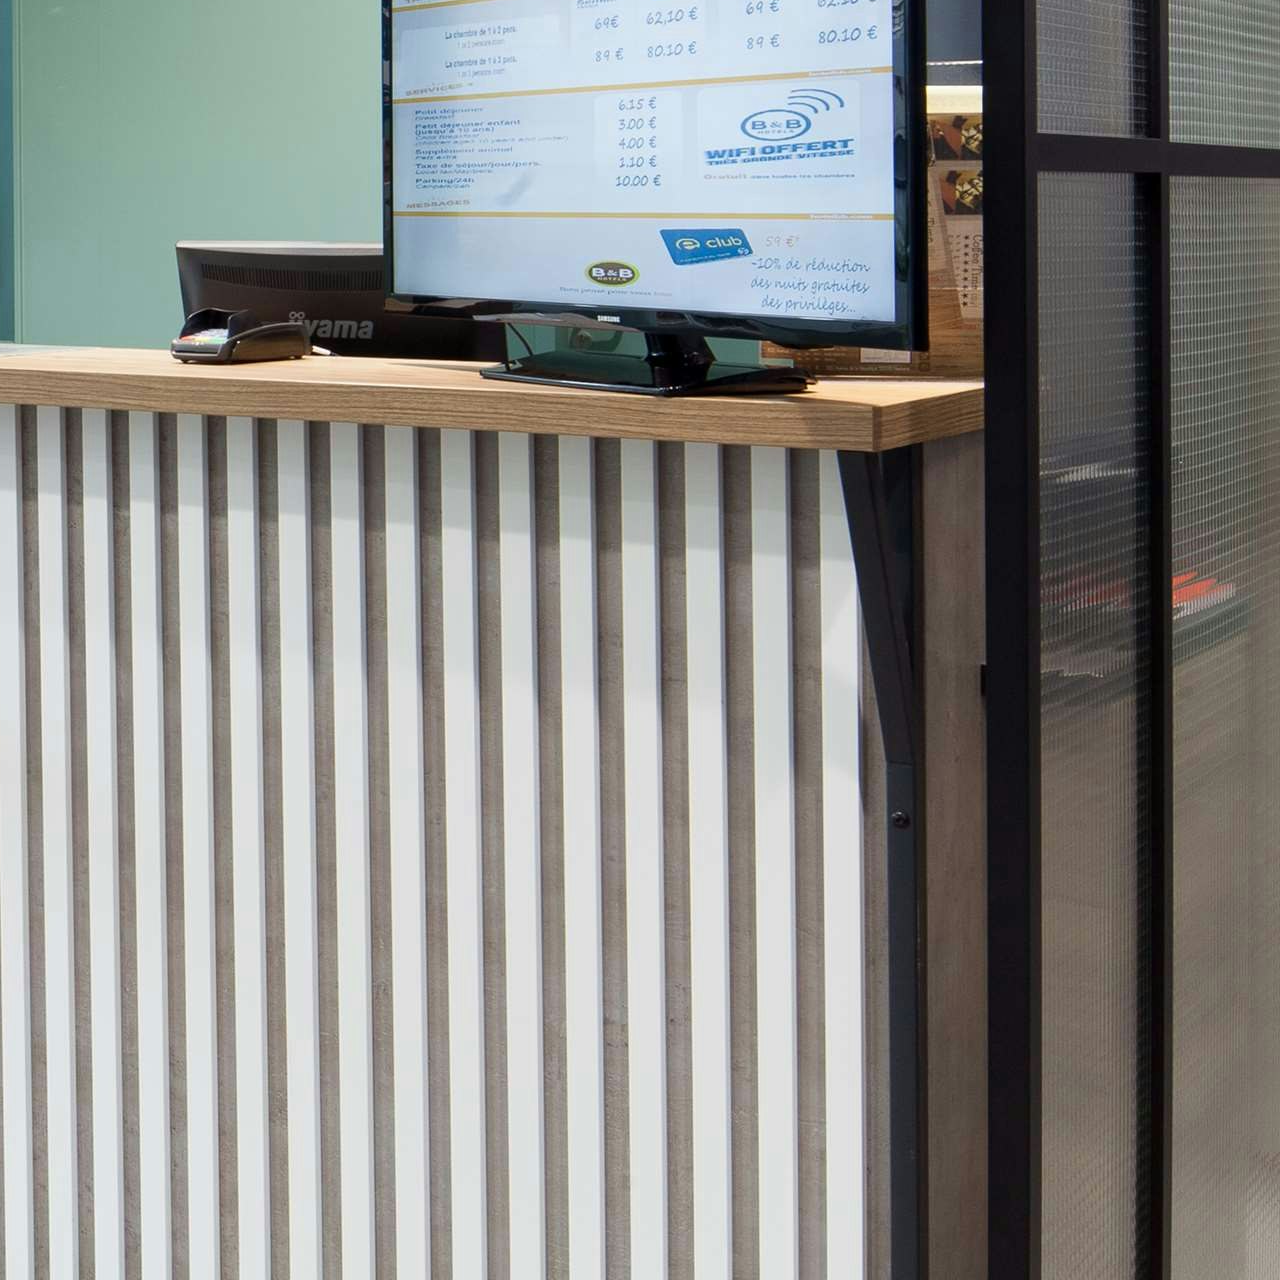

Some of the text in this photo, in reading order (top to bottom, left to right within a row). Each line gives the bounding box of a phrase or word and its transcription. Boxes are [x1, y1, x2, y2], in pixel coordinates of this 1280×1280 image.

[688, 7, 698, 20] €
[746, 1, 764, 15] 69
[818, 25, 878, 44] 80.10 €
[746, 34, 780, 50] 89 €
[595, 50, 610, 62] 89
[648, 96, 657, 109] €
[648, 116, 657, 129] €
[751, 118, 802, 130] B&B
[648, 135, 657, 148] €
[705, 138, 855, 160] WIFI OFFERT
[648, 155, 657, 167] €
[653, 174, 662, 186] €
[706, 236, 743, 249] club
[786, 257, 801, 270] de
[806, 259, 871, 272] réduction
[592, 268, 633, 278] B&B
[751, 278, 870, 295] des nuits gratuites
[761, 295, 782, 309] des
